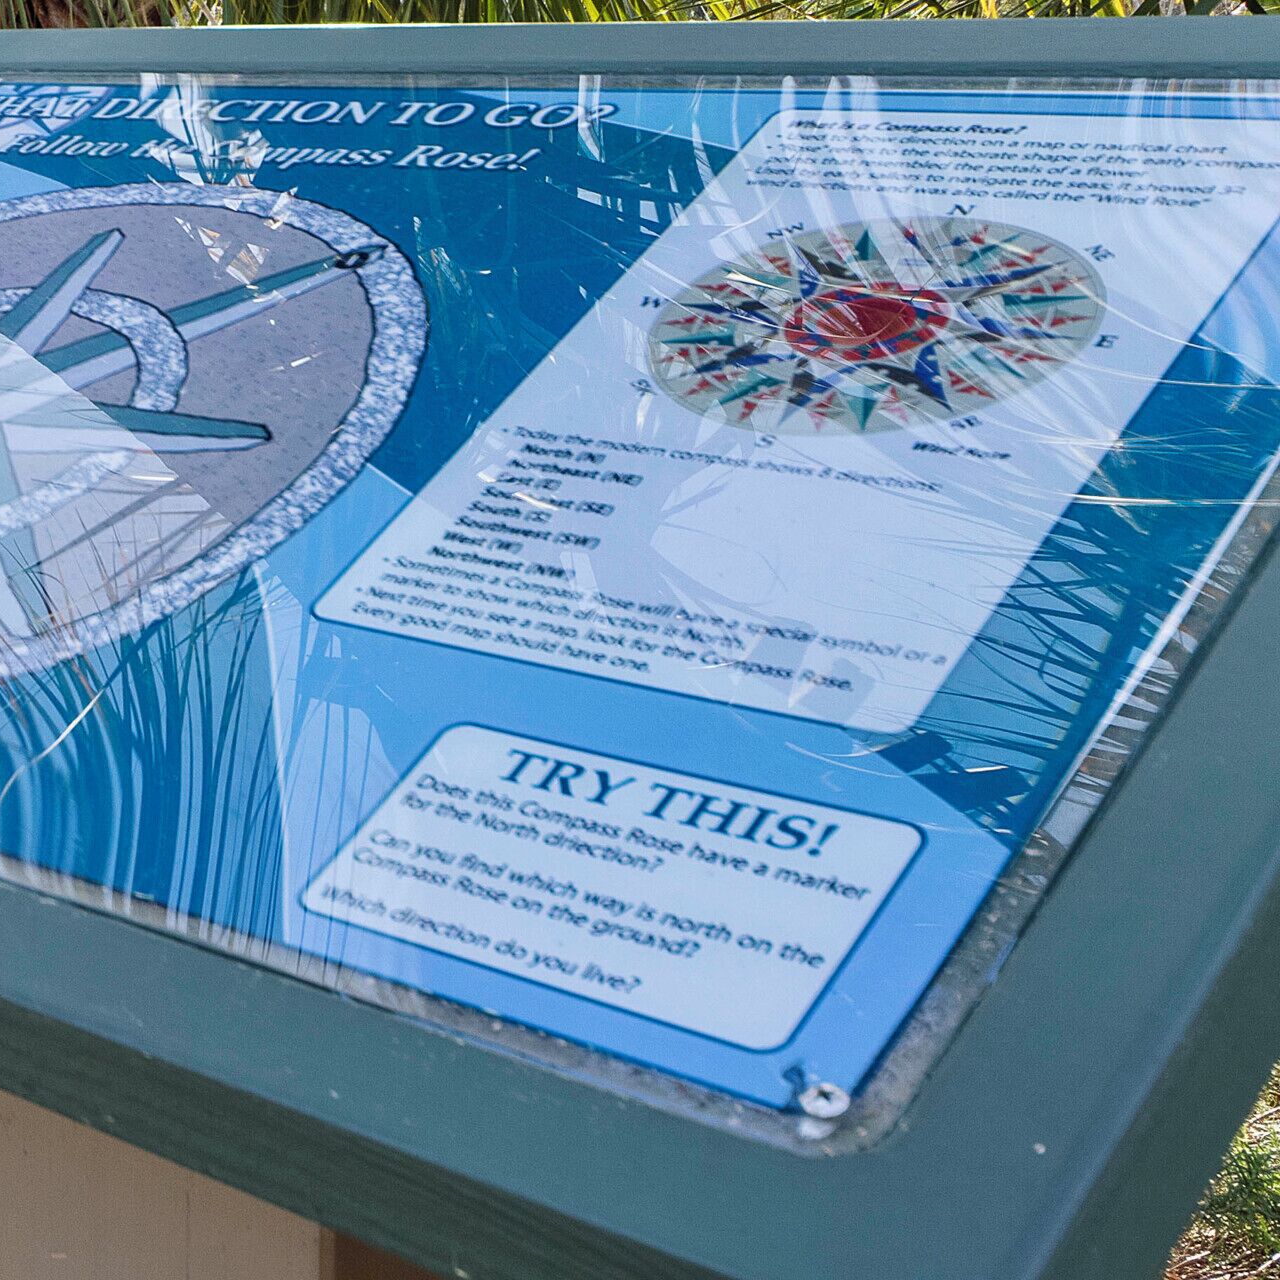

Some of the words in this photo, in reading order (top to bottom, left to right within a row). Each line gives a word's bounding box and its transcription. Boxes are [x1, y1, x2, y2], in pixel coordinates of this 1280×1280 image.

[389, 101, 476, 126] TO
[483, 102, 619, 129] GO?
[788, 120, 838, 130] What
[874, 121, 961, 134] Compass
[964, 123, 1028, 134] Rose?
[130, 137, 200, 159] the
[208, 139, 393, 170] Cmpass
[394, 144, 541, 170] Rose!
[900, 136, 977, 146] direction
[1023, 141, 1066, 150] map
[1093, 142, 1172, 152] nautical
[1175, 145, 1227, 154] chart
[901, 147, 930, 156] the
[933, 148, 1019, 160] elaborate
[1022, 152, 1078, 163] shape
[1142, 157, 1190, 168] early
[955, 162, 984, 171] the
[987, 163, 1042, 174] petals
[914, 187, 948, 195] was
[951, 188, 990, 197] also
[993, 190, 1050, 201] called
[1052, 192, 1085, 202] the
[948, 175, 1028, 187] navigate
[1031, 179, 1063, 187] the
[1135, 183, 1217, 194] showed
[947, 203, 977, 216] N
[766, 222, 804, 239] NW
[1083, 243, 1116, 263] NE
[1095, 334, 1119, 348] E
[520, 443, 574, 460] North
[575, 450, 607, 466] (N)
[754, 434, 777, 448] S
[564, 433, 594, 446] the
[595, 438, 667, 457] modern
[669, 448, 749, 468] compass
[754, 460, 813, 477] shows
[496, 471, 535, 486] East
[506, 458, 600, 480] Northeast
[600, 470, 644, 487] (NE)
[467, 500, 522, 518] South
[481, 486, 575, 510] Souast
[575, 499, 615, 517] (SE)
[443, 530, 487, 546] West
[487, 538, 524, 554] (W)
[454, 515, 552, 540] Southwest
[552, 531, 601, 550] (SW)
[427, 545, 524, 571] Northwest
[380, 572, 439, 590] marker
[464, 588, 513, 605] show
[515, 596, 571, 617] which
[573, 608, 658, 633] direction
[392, 556, 485, 582] Sometimes
[503, 576, 584, 601] Compass
[638, 604, 675, 618] will
[819, 633, 902, 657] symbol
[904, 647, 930, 662] or
[351, 600, 395, 621] Every
[398, 609, 448, 631] good
[449, 621, 491, 642] map
[493, 629, 558, 654] should
[560, 643, 607, 665] have
[366, 586, 406, 604] Next
[406, 594, 448, 613] time
[448, 604, 485, 620] you
[486, 611, 518, 626] see
[583, 626, 626, 648] look
[629, 637, 660, 654] for
[662, 643, 697, 661] the
[700, 649, 793, 680] Compass
[402, 790, 435, 812] for
[434, 801, 473, 823] the
[474, 809, 541, 841] North
[498, 747, 638, 806] TRY
[642, 782, 841, 858] THIS!
[416, 773, 471, 801] Does
[474, 787, 515, 812] this
[518, 798, 623, 840] Compass
[625, 826, 685, 856] Rose
[688, 841, 749, 871] have
[753, 861, 770, 877] a
[774, 865, 871, 901] marker
[352, 846, 451, 888] Compass
[452, 874, 509, 905] Rose
[510, 894, 545, 915] on
[546, 902, 589, 928] the
[589, 918, 702, 959] ground?
[369, 828, 411, 851] Can
[411, 842, 457, 867] you
[457, 851, 509, 879] find
[509, 869, 579, 901] which
[583, 889, 634, 918] way
[636, 902, 658, 922] is
[658, 911, 733, 944] north
[736, 933, 773, 955] on
[778, 941, 826, 970] the
[321, 882, 388, 917] Which
[389, 905, 492, 950] direction
[493, 937, 529, 961] do
[528, 948, 580, 977] you
[581, 960, 644, 995] live?
